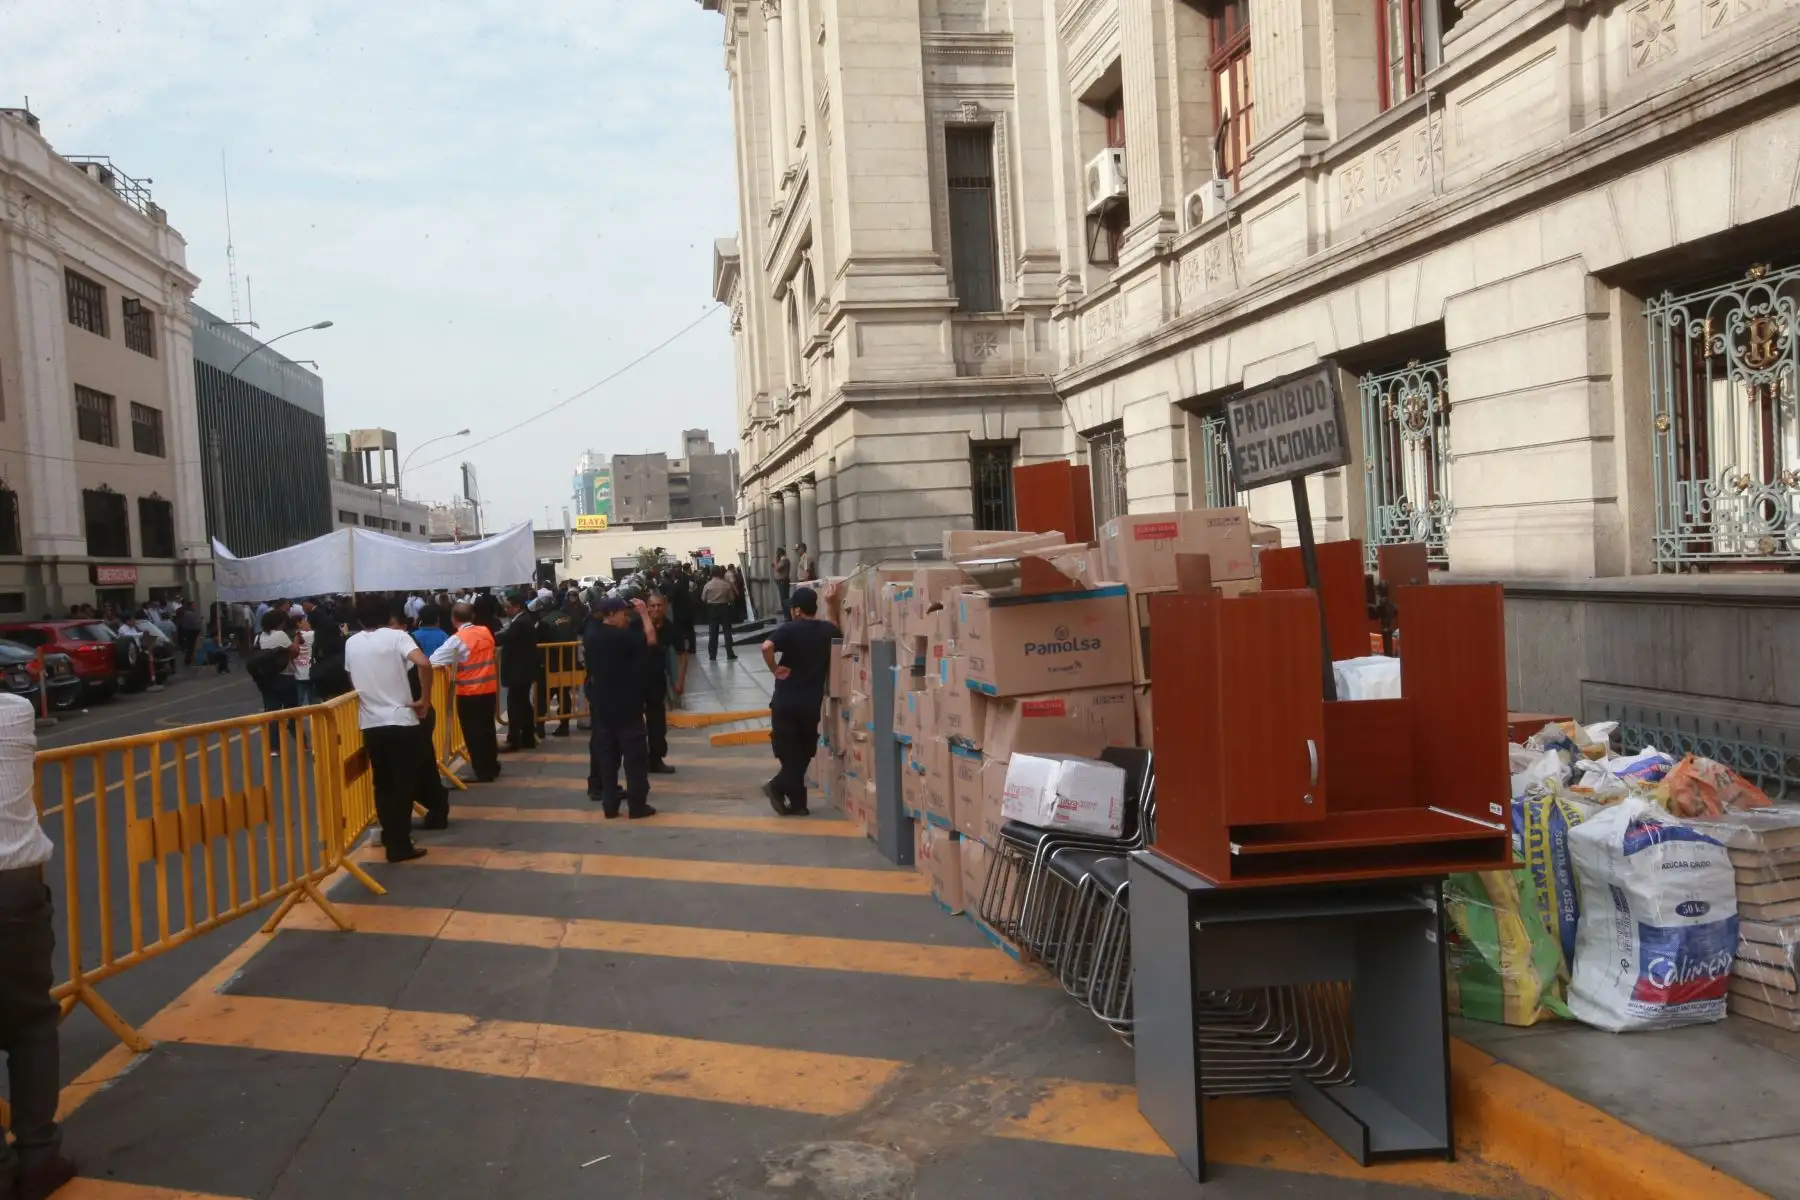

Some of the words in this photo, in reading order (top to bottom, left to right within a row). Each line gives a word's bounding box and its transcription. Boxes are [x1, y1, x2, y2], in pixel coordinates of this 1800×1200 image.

[1233, 379, 1327, 437] PROHIBIDO
[1235, 419, 1337, 475] ESTACIONAR
[577, 518, 606, 526] PLAYA
[1024, 636, 1102, 657] Pamolsa
[1562, 890, 1575, 922] PESO
